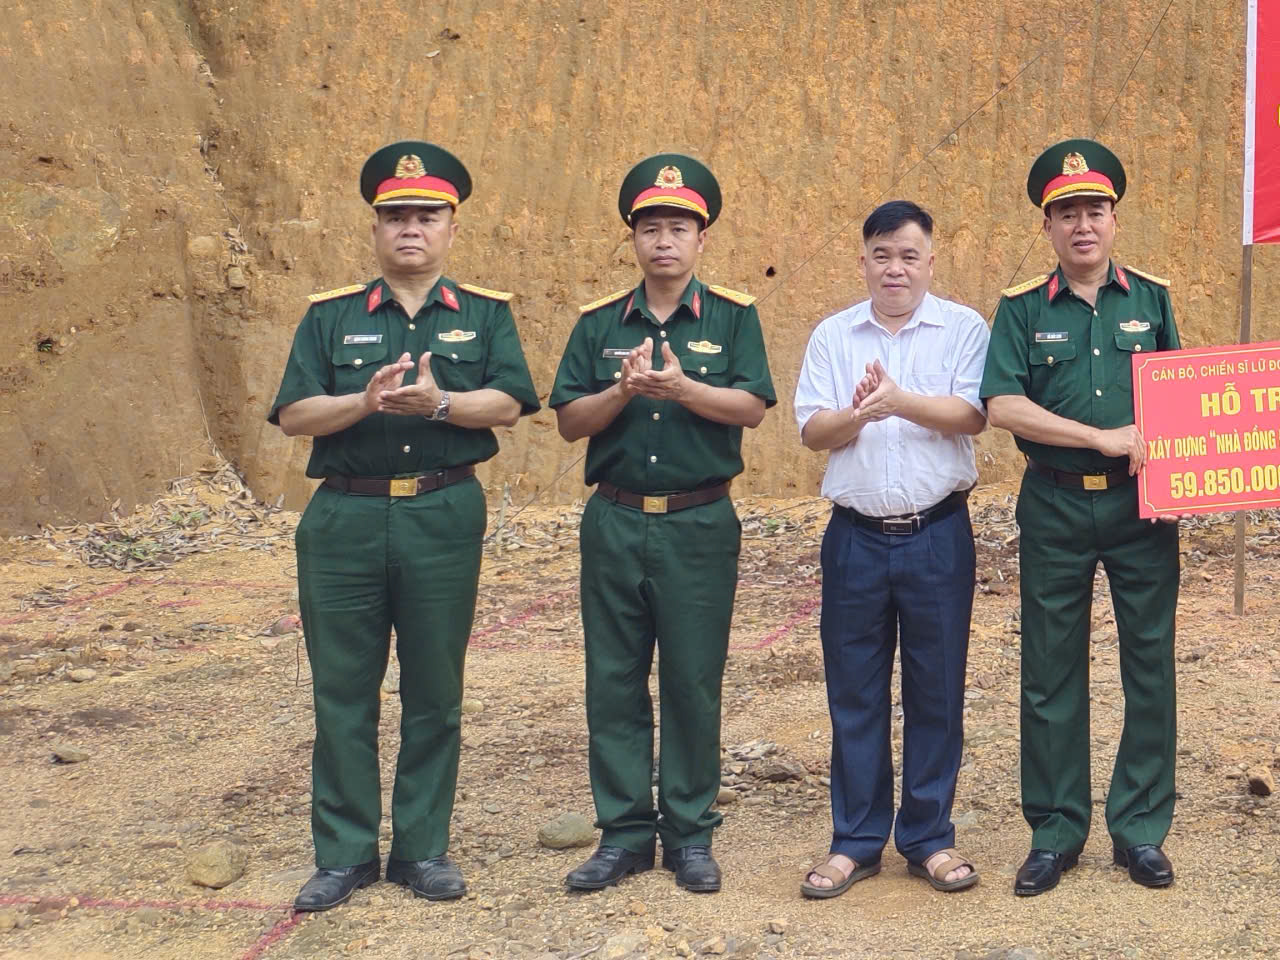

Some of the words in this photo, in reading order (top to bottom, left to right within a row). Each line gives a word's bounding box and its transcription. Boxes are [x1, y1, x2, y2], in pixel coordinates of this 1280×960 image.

[1200, 359, 1235, 377] CHIẾN
[1201, 381, 1241, 417] HỖ
[1148, 435, 1171, 460] XÂY
[1174, 434, 1207, 462] DỰNG
[1243, 424, 1276, 451] ĐỒNG
